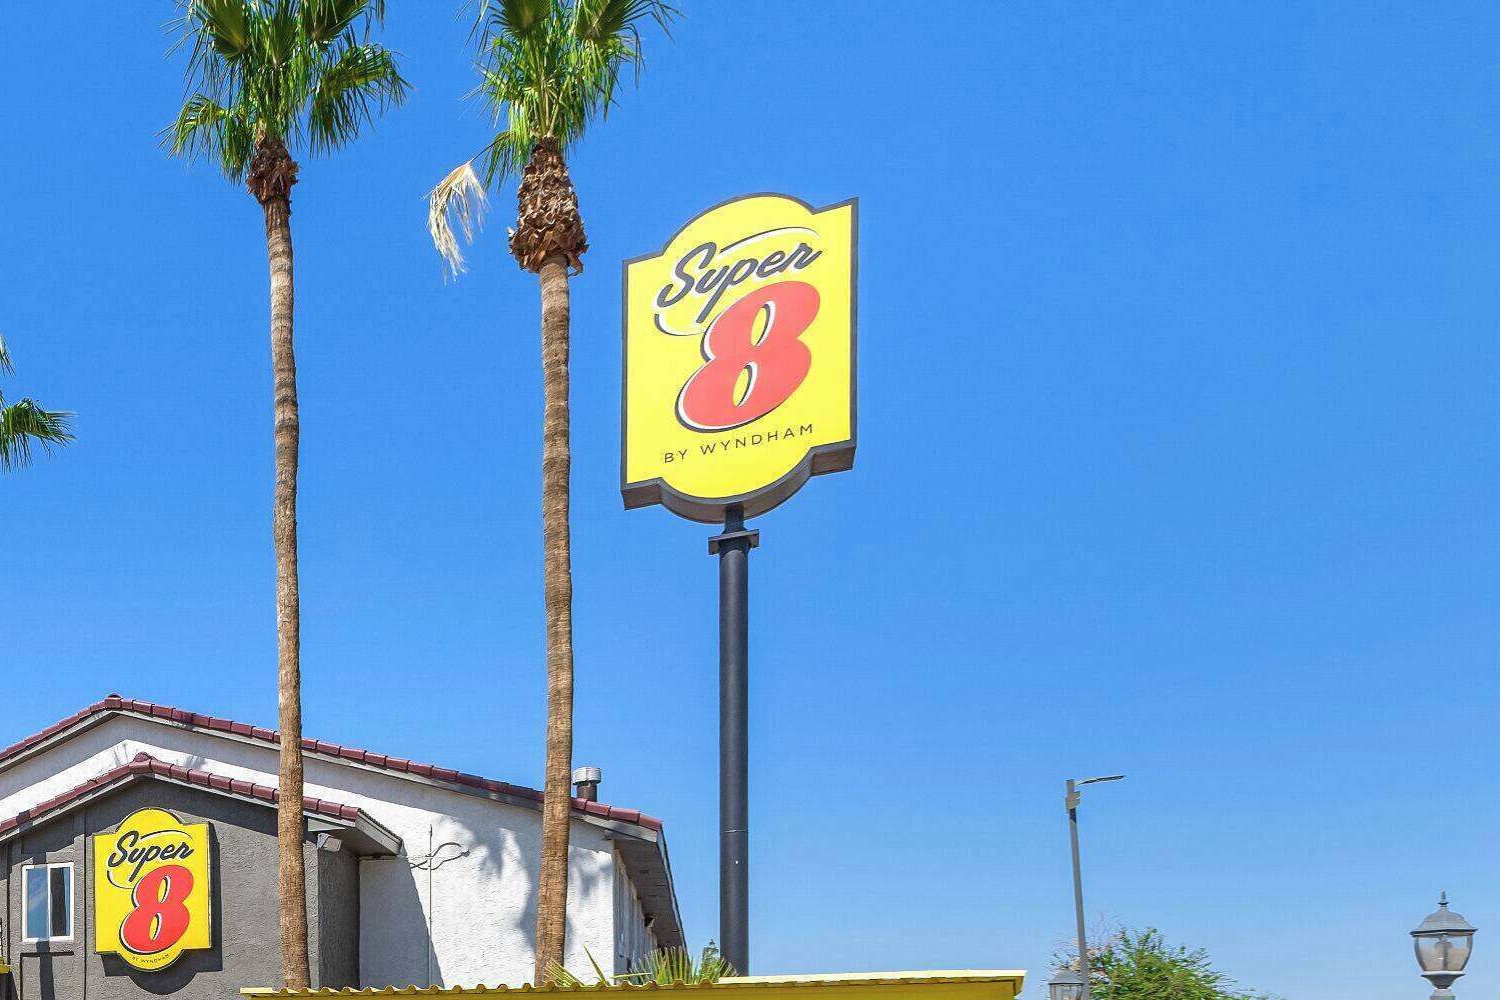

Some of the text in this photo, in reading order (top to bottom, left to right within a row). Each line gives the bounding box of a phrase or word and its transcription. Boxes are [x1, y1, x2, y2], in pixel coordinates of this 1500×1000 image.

[656, 241, 824, 324] Super
[674, 280, 821, 434] 8
[664, 423, 814, 464] BY WYNDHAM
[107, 830, 195, 883] Super
[118, 864, 195, 956] 8
